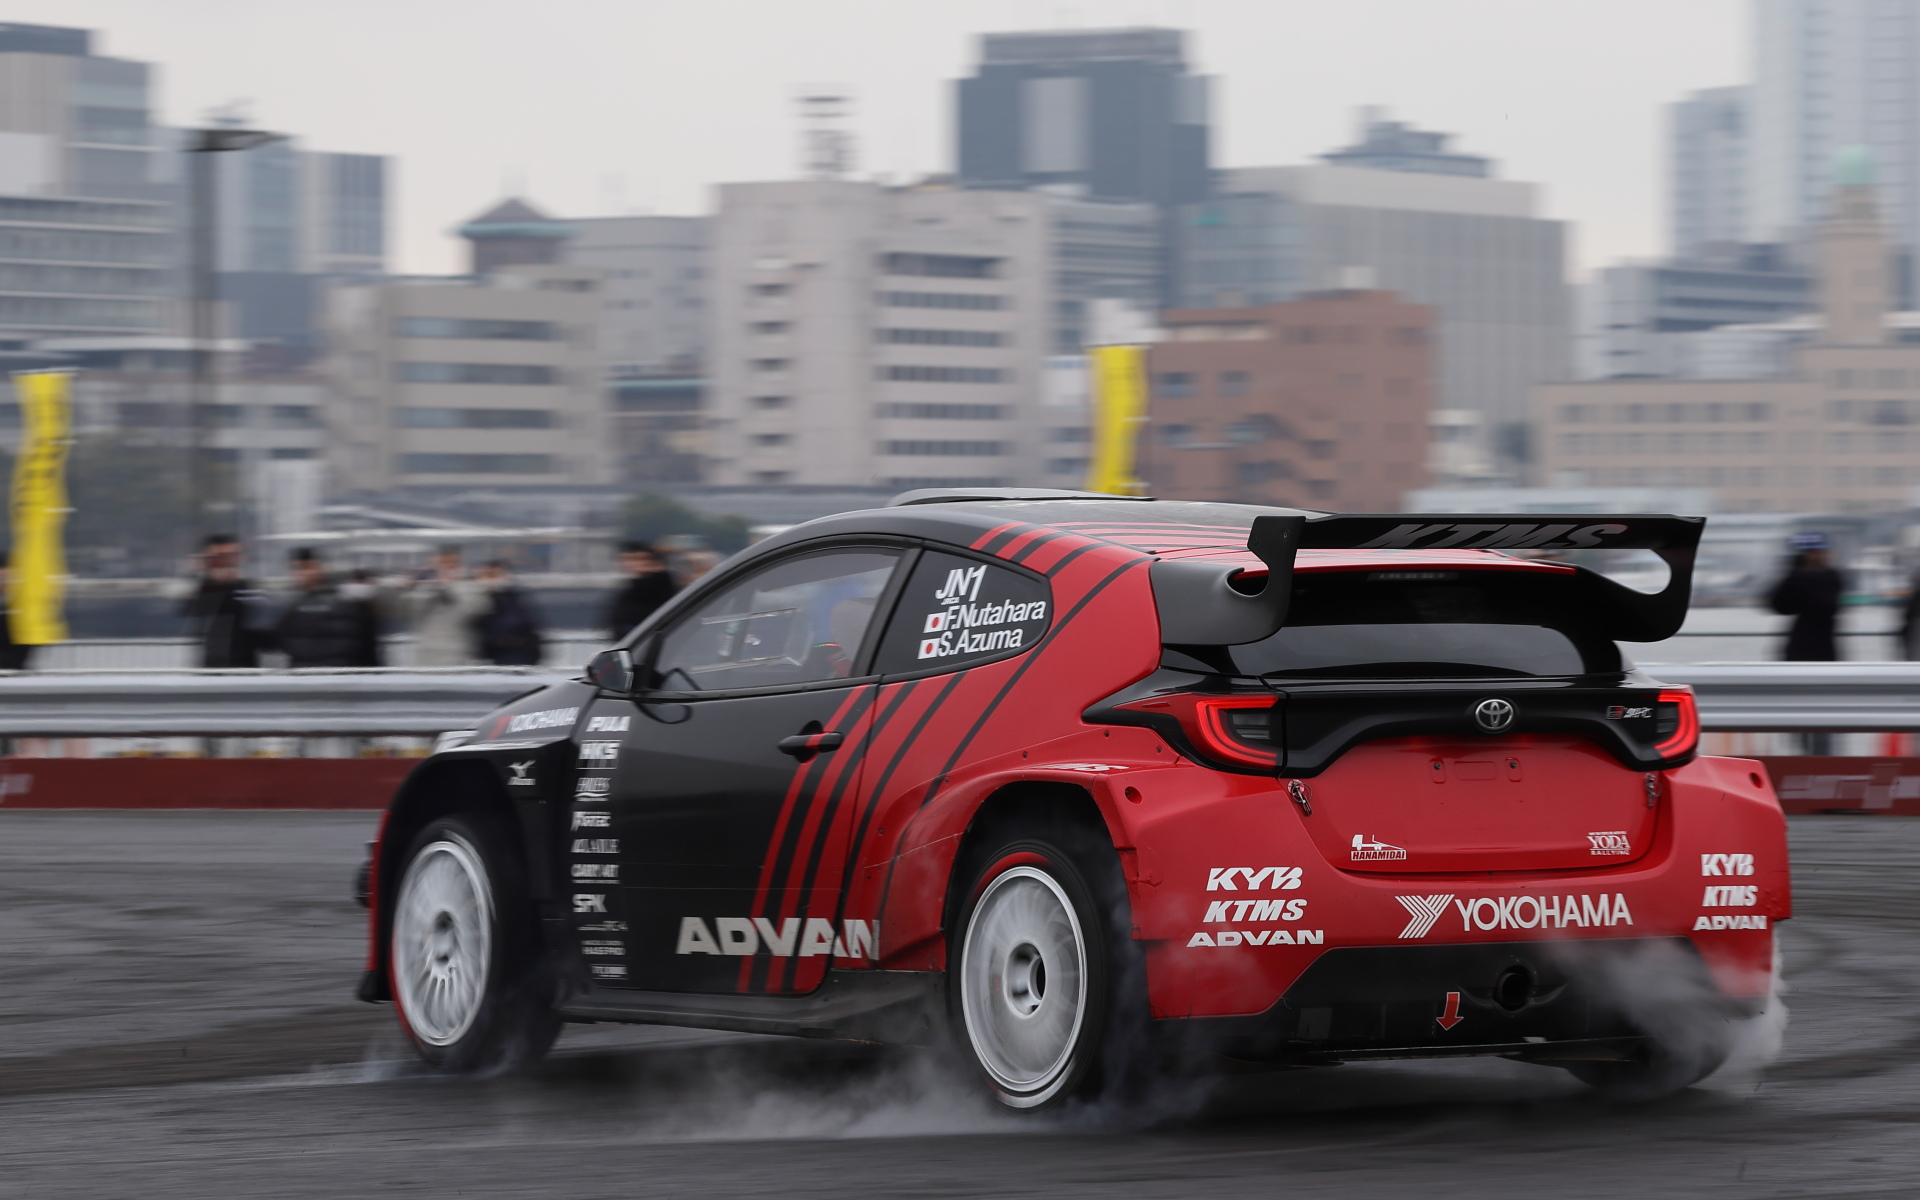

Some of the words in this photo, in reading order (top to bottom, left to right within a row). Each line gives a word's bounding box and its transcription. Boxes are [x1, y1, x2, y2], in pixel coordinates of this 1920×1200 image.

[1354, 523, 1628, 548] KTMS
[935, 564, 988, 601] JN1
[944, 599, 1047, 631] F.Nutahara
[938, 628, 1024, 657] S.Azuma
[578, 742, 620, 760] HKS
[1586, 834, 1631, 850] YODA
[1352, 850, 1405, 860] HANAMIDAI
[1700, 853, 1754, 877] KYB
[1206, 866, 1303, 891] KYB
[1702, 885, 1758, 907] KTMS
[1202, 898, 1307, 923] KTMS
[1454, 893, 1633, 932] YOKOHAMA
[1692, 915, 1767, 931] ADVAN
[675, 916, 880, 960] ADVAN
[1186, 929, 1324, 948] ADVAN
